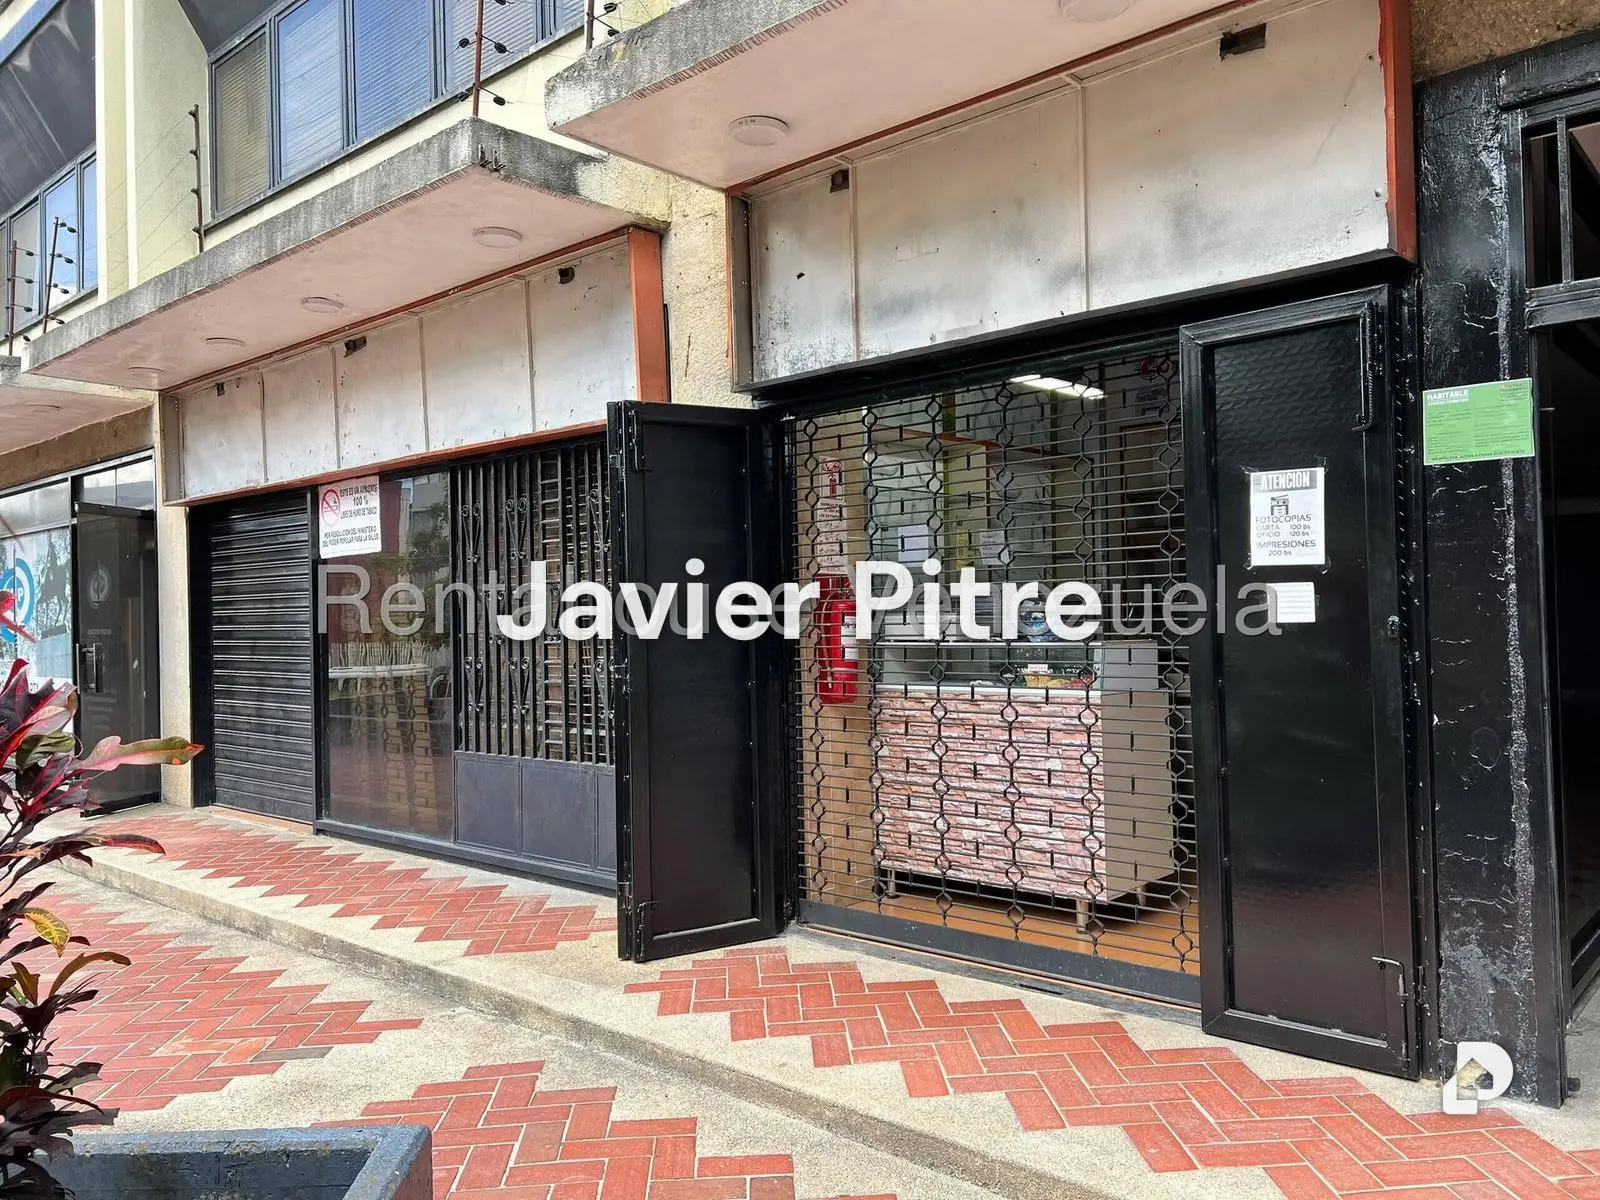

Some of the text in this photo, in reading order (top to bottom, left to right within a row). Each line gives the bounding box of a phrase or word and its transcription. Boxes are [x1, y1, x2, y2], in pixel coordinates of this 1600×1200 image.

[1426, 389, 1469, 400] HABITABLE
[1261, 471, 1311, 491] ATENCION
[1255, 514, 1312, 524] FOTOCOPIAS
[1256, 524, 1280, 532] CARTA
[1255, 540, 1316, 550] IMPRESIONES
